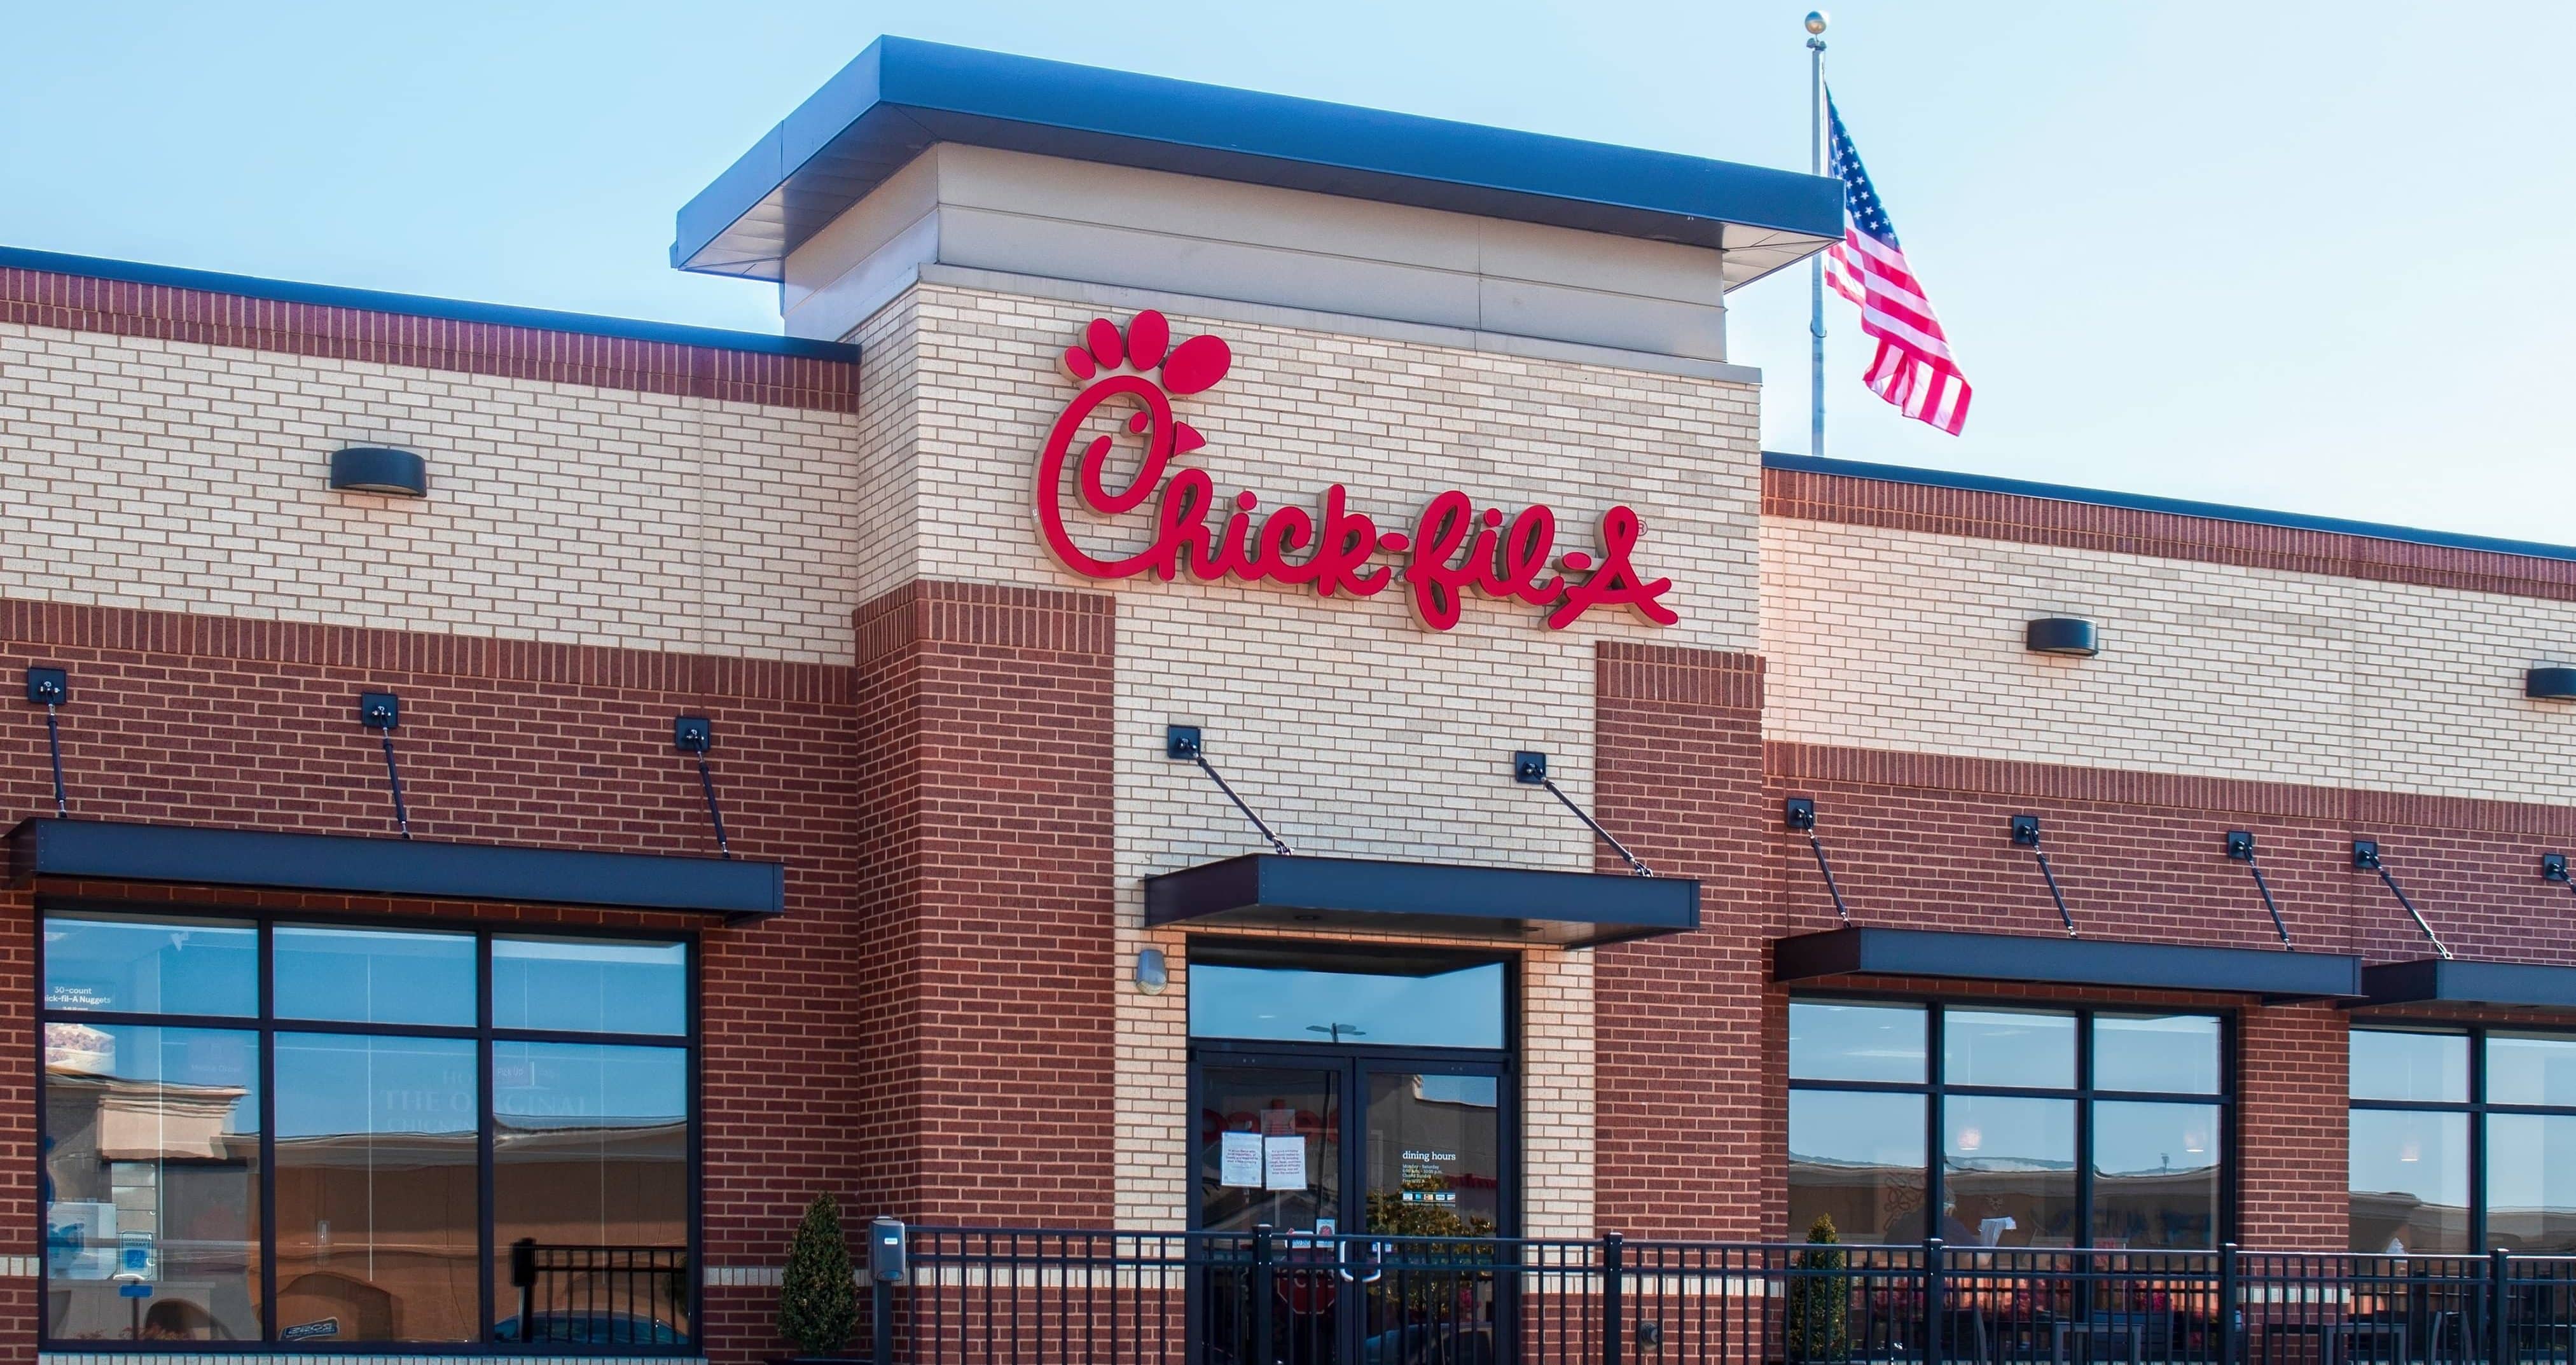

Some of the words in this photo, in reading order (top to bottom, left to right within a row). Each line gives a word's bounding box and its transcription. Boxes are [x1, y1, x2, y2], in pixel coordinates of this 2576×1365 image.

[1032, 374, 1679, 634] Chick-fil-A
[55, 986, 92, 994] 30-count
[80, 996, 111, 1005] Nuggets
[449, 1090, 586, 1115] OIGINAL
[1402, 1151, 1429, 1162] dining
[1432, 1151, 1456, 1160] hours
